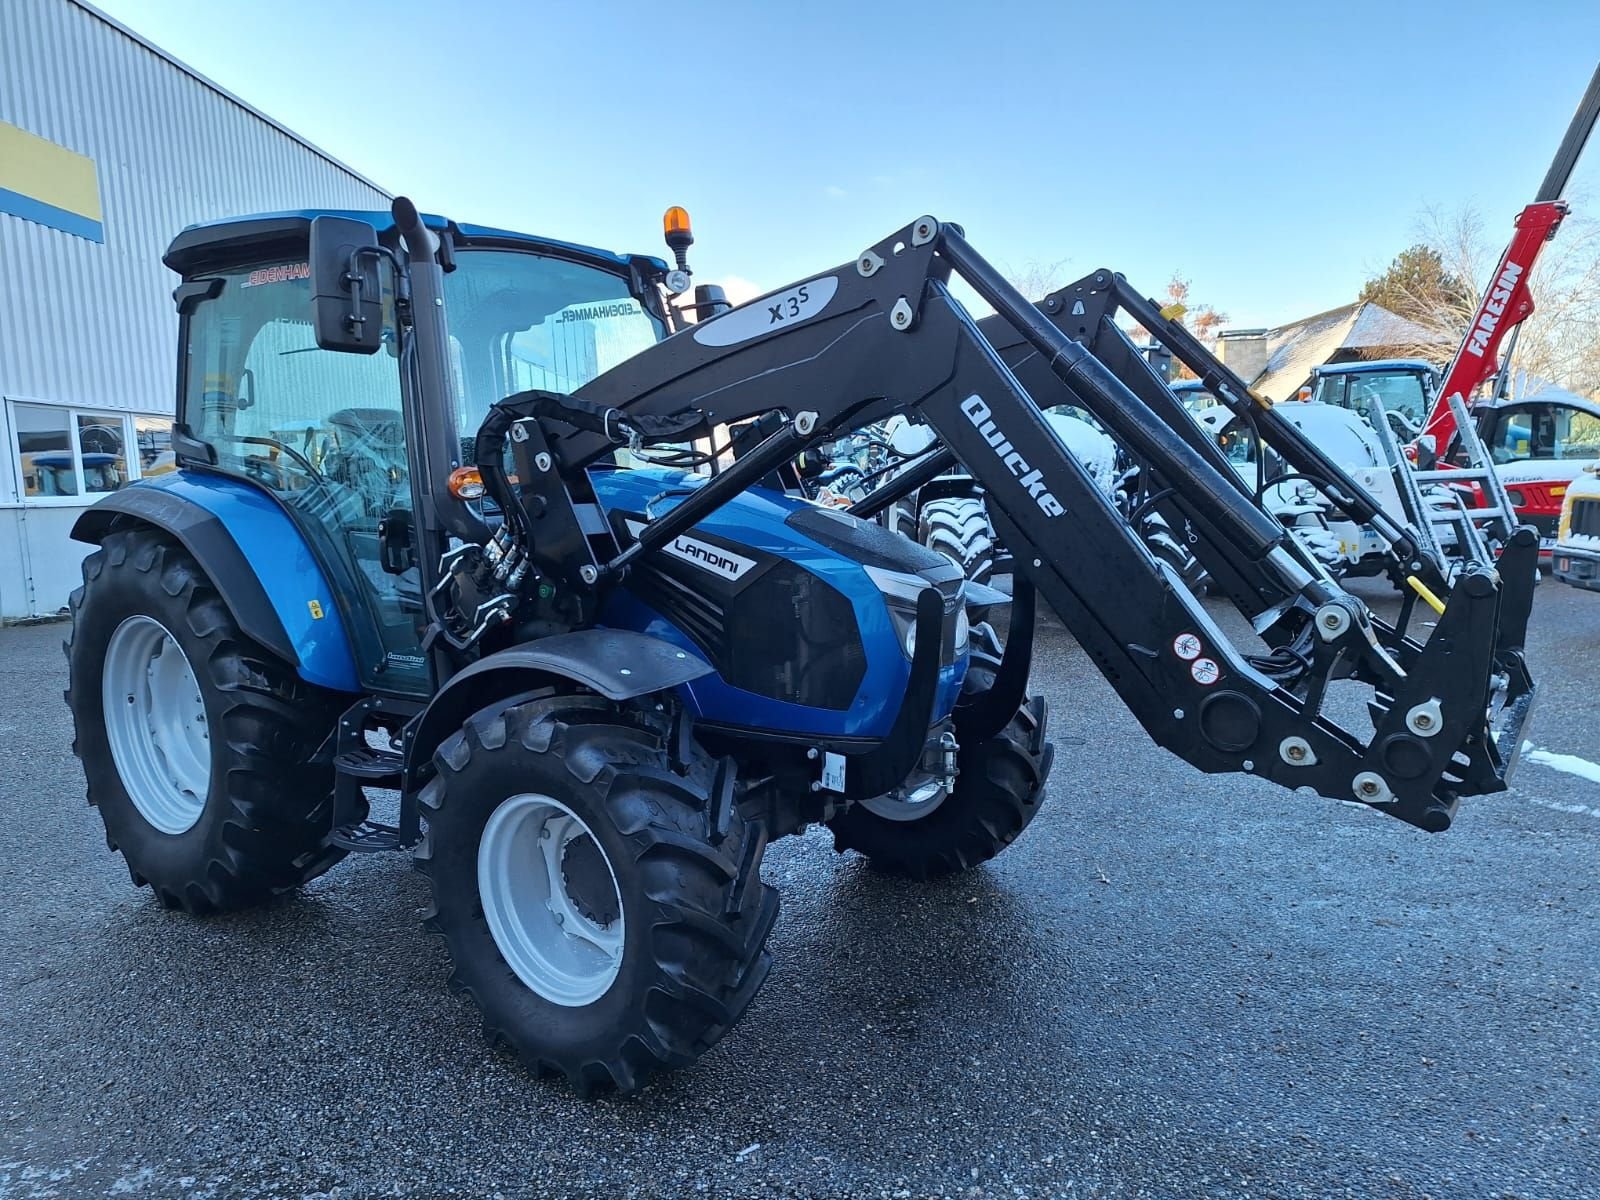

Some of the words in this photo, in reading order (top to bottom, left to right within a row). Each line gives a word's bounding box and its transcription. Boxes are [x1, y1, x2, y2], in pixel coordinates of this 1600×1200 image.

[1467, 260, 1523, 358] FARESIN
[960, 394, 1065, 518] Quicke
[674, 539, 739, 574] LANDINI
